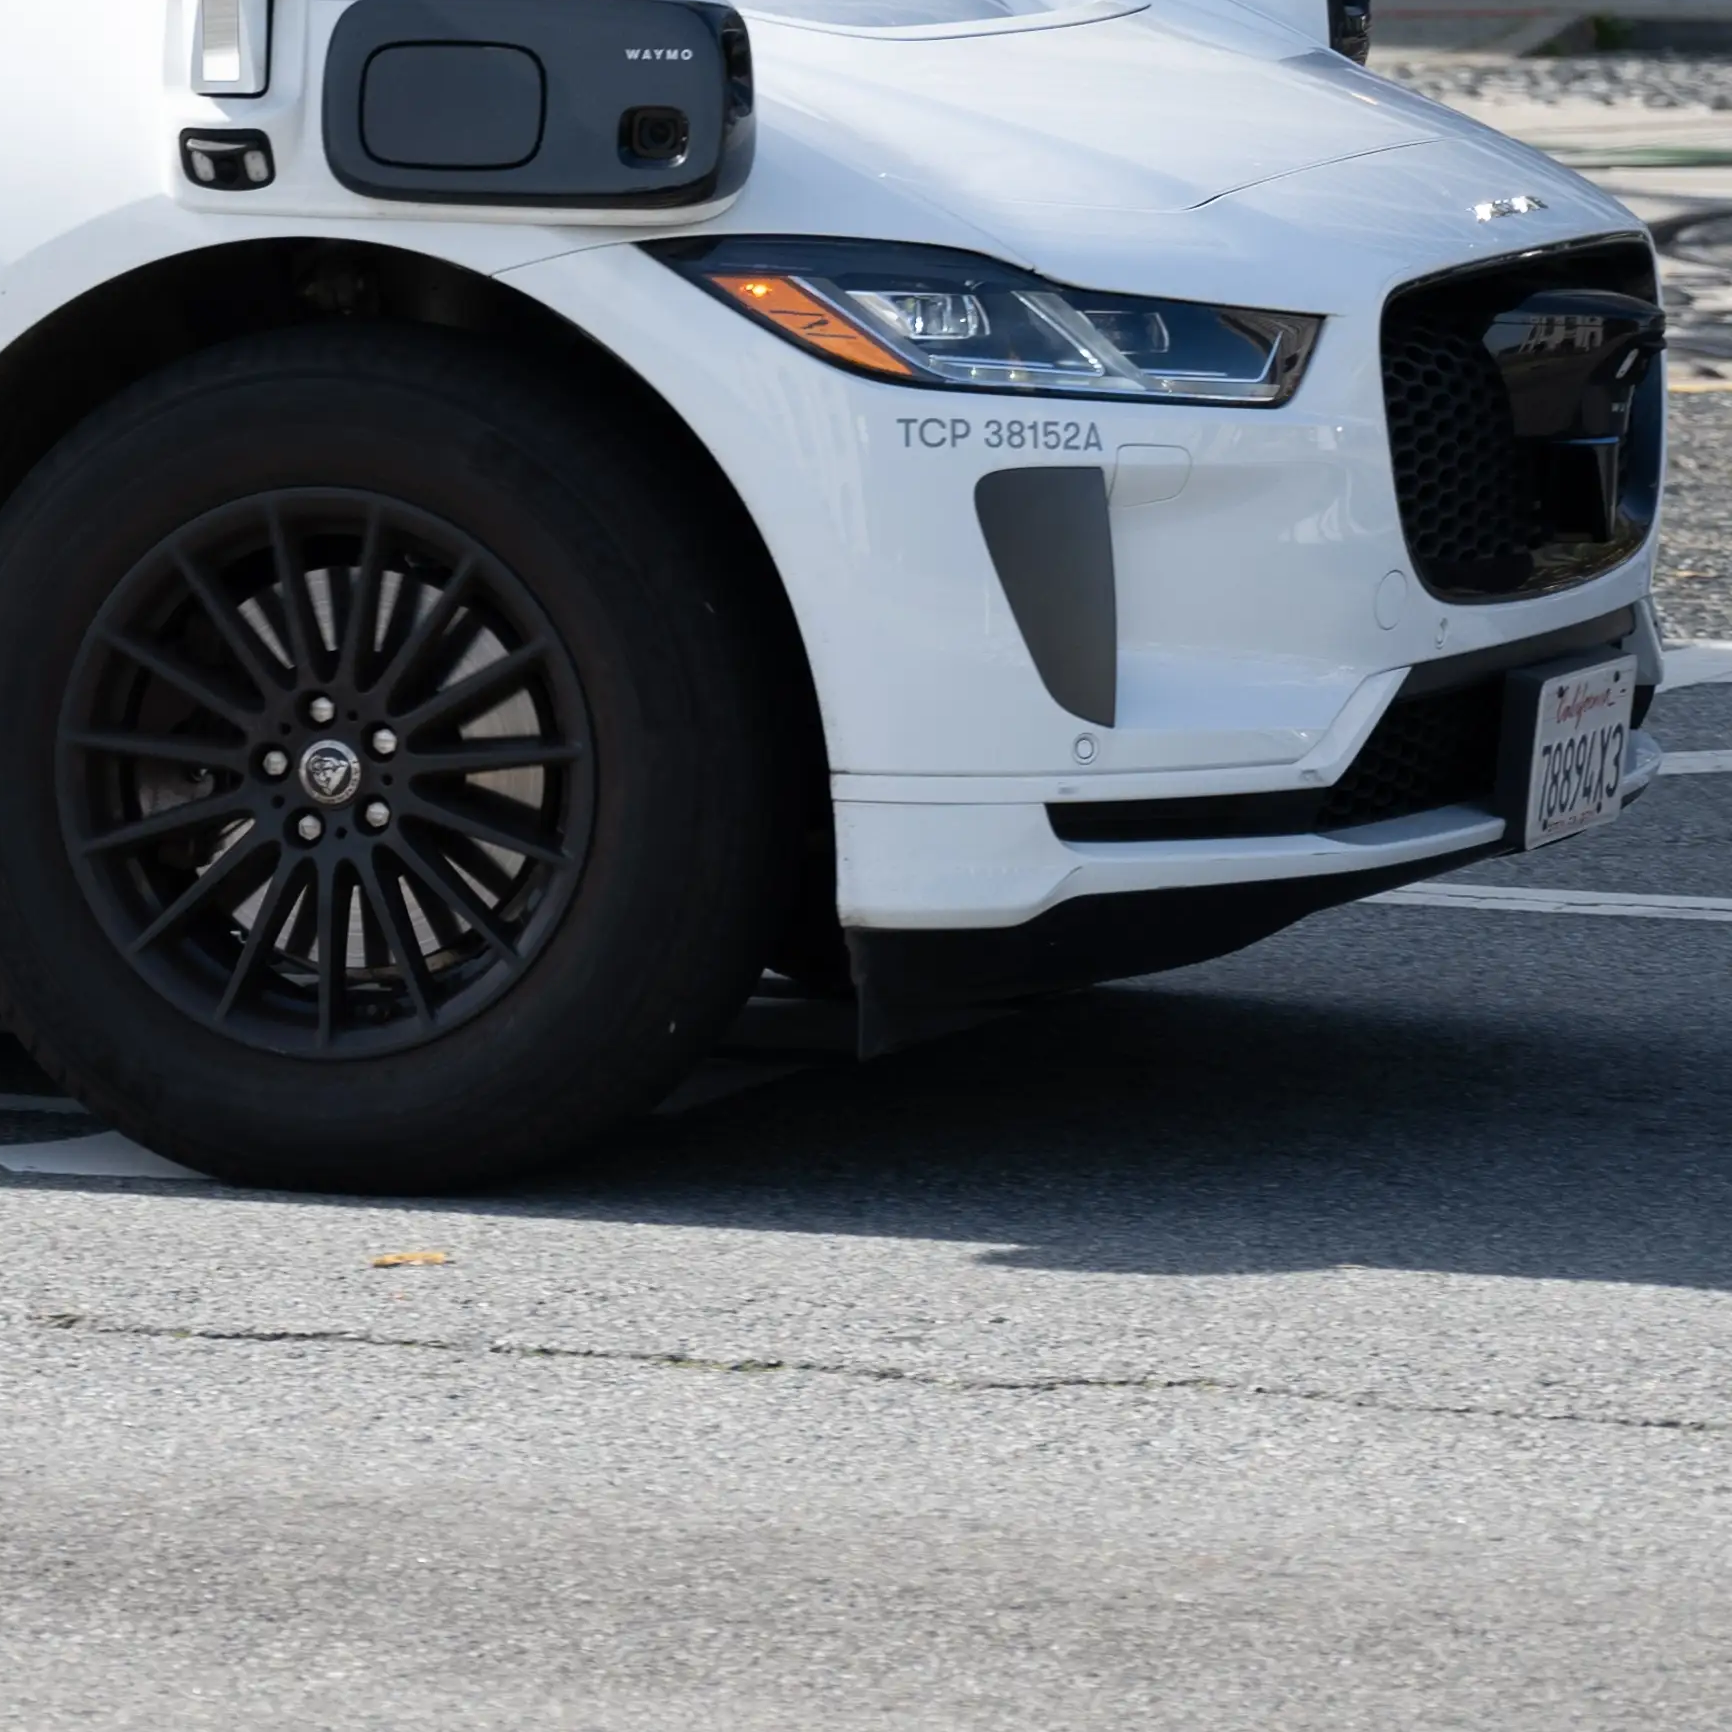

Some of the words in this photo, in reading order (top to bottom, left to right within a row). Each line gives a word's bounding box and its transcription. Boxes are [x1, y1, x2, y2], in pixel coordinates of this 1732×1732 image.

[625, 48, 694, 62] WAYMO
[897, 417, 970, 449] TCP
[984, 420, 1104, 452] 38152A
[1538, 722, 1624, 823] 78894X3
